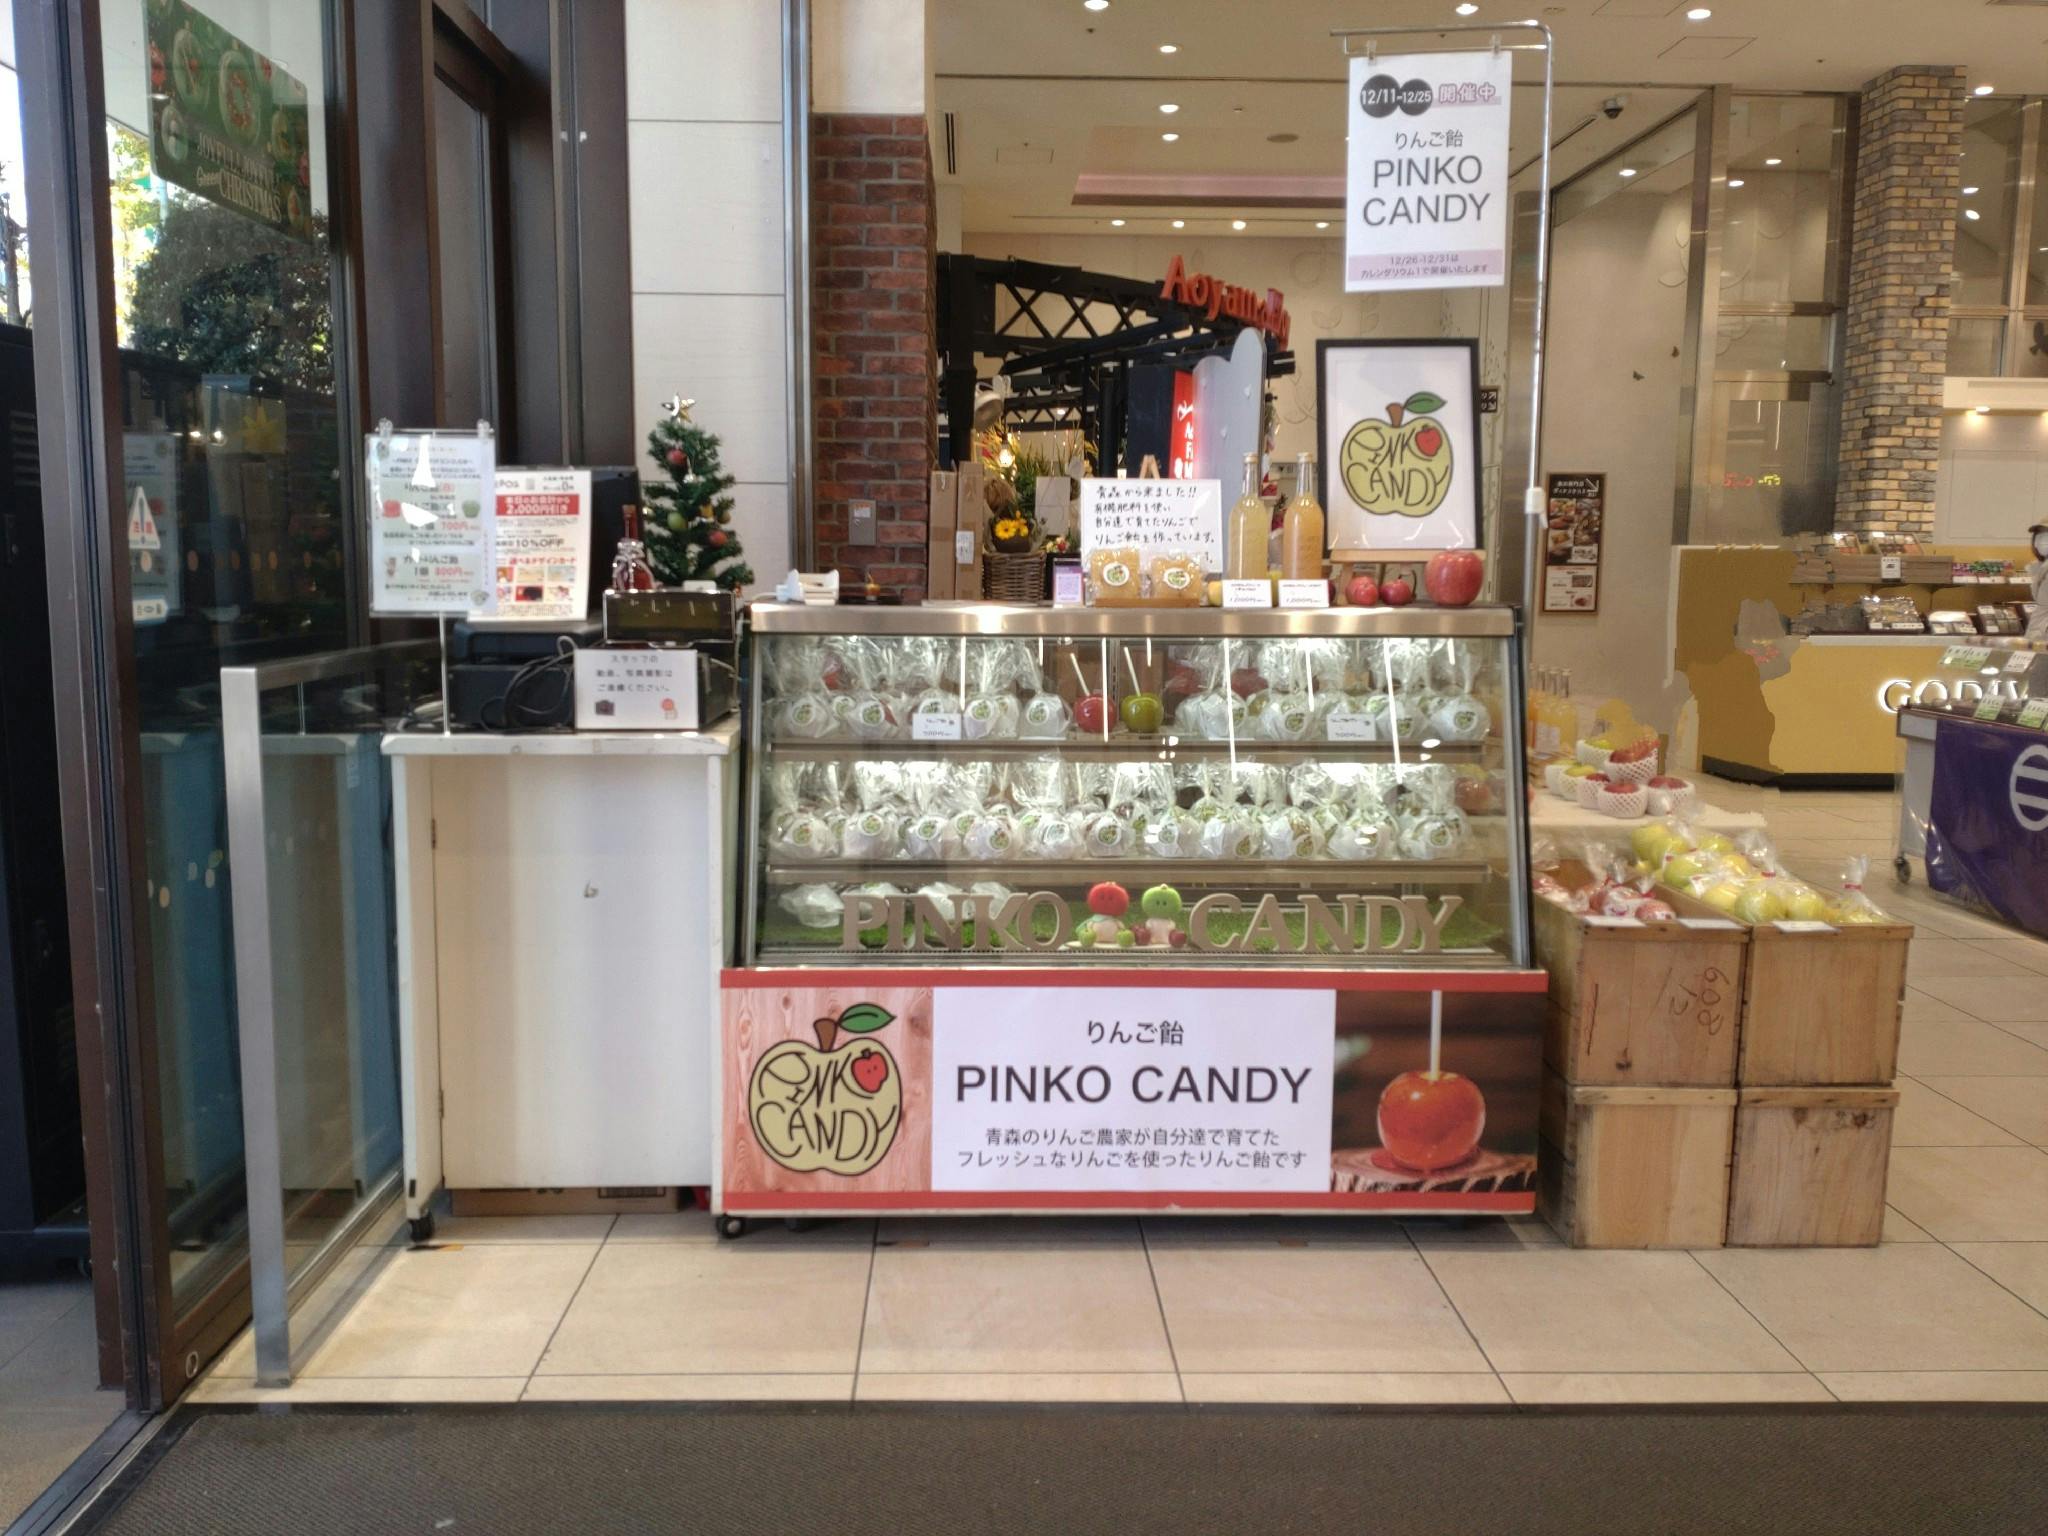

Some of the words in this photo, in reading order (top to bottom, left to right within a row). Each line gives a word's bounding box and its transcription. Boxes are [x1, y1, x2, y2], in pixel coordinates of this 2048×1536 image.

[1439, 82, 1496, 103] 開催中
[1395, 129, 1464, 150] りんご飴
[1374, 155, 1482, 188] PINKO
[1363, 193, 1491, 226] CANDY
[1346, 463, 1449, 507] CANDY
[839, 891, 1072, 952] PINKO
[1190, 893, 1465, 954] CANDY
[1087, 1020, 1184, 1046] りんご飴
[956, 1065, 1112, 1103] PINKO
[1131, 1066, 1312, 1104] CANDY
[756, 1101, 897, 1162] CANDY
[985, 1128, 1280, 1147] 青森のりんご農家が自分達で育てた
[958, 1150, 1307, 1169] フレッシュなりんごを使ったりんご飴です
